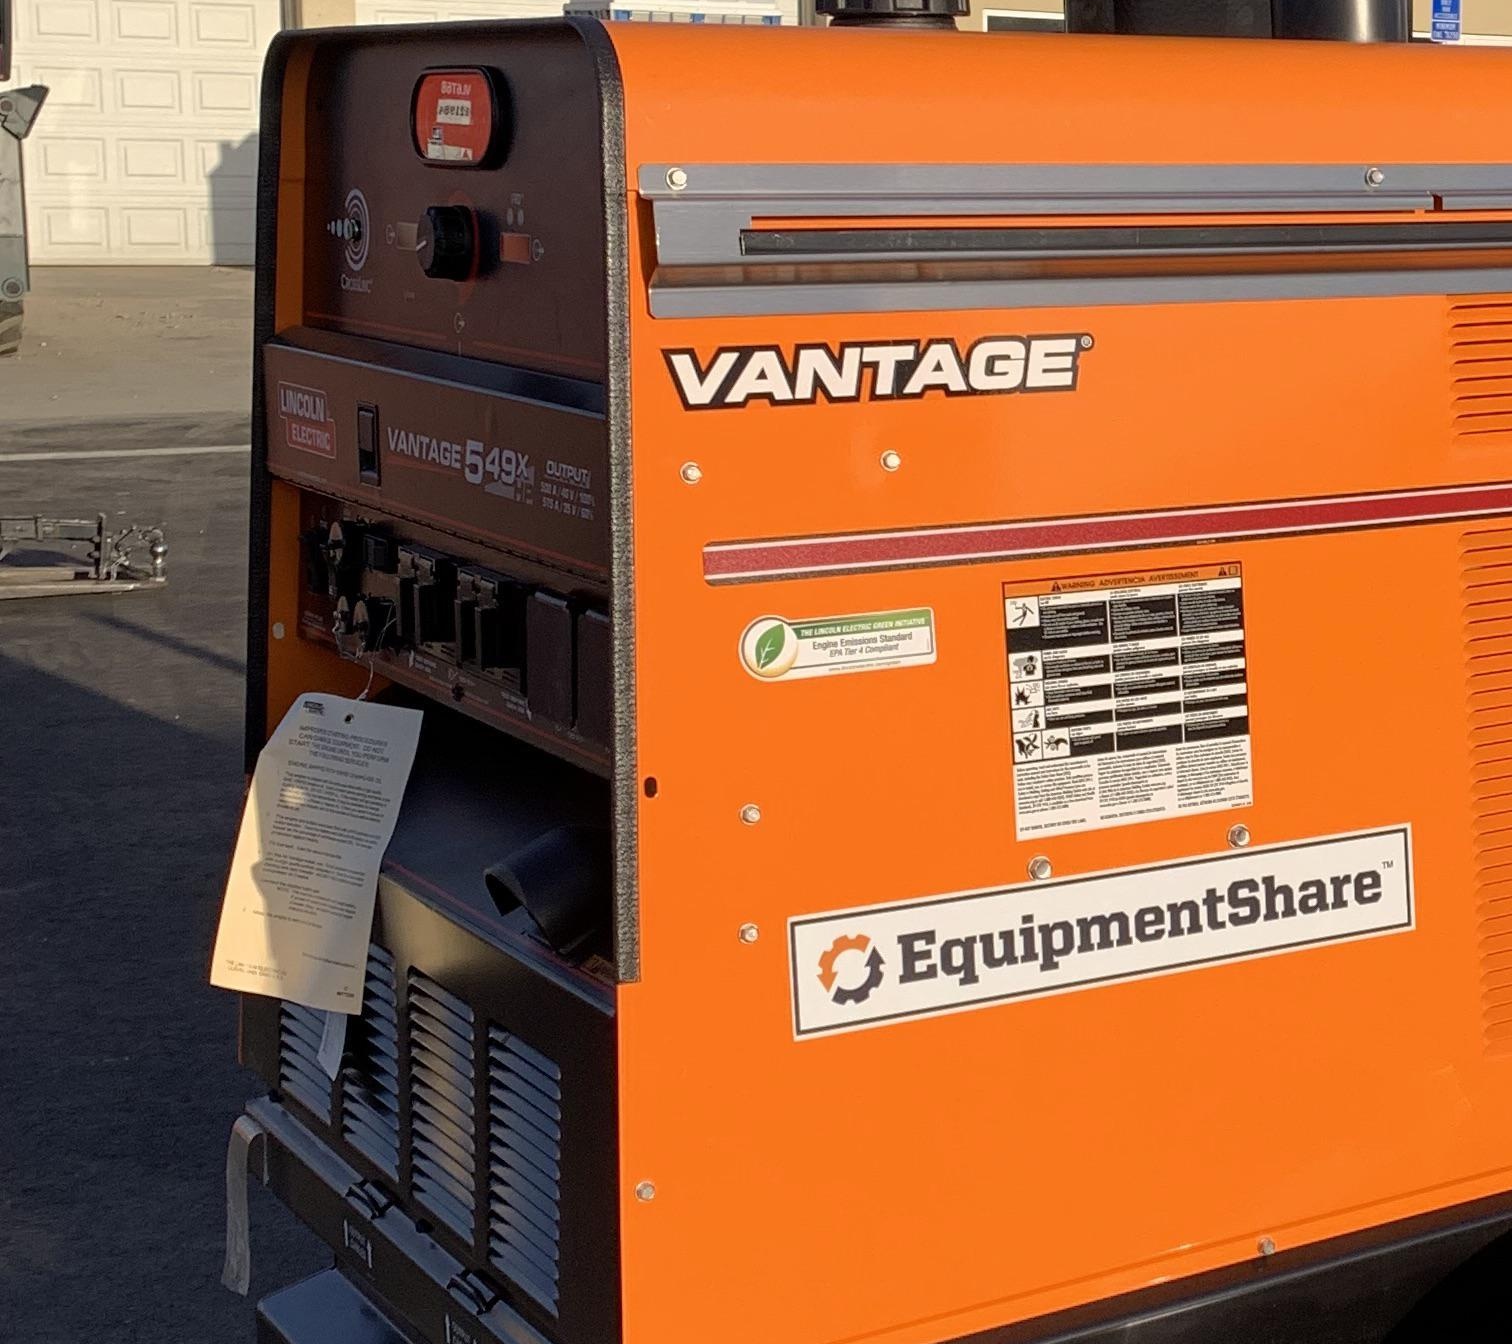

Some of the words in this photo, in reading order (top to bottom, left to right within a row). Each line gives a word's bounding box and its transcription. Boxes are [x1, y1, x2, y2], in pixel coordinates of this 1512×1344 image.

[280, 388, 325, 422] LINCOLN
[291, 424, 331, 451] ELECTRIC
[387, 426, 462, 470] VANTAGE
[464, 439, 528, 485] 549X
[546, 459, 589, 483] OUTPUT
[1060, 579, 1096, 590] WARNING
[800, 628, 813, 637] THE
[814, 625, 841, 635] LINCOLN
[842, 623, 872, 633] ELECTRIC
[812, 640, 838, 651] Engine
[840, 635, 878, 646] Emissions
[879, 631, 912, 643] Standard
[829, 648, 843, 657] EPA
[844, 646, 857, 656] Tier
[865, 642, 900, 654] Compliant
